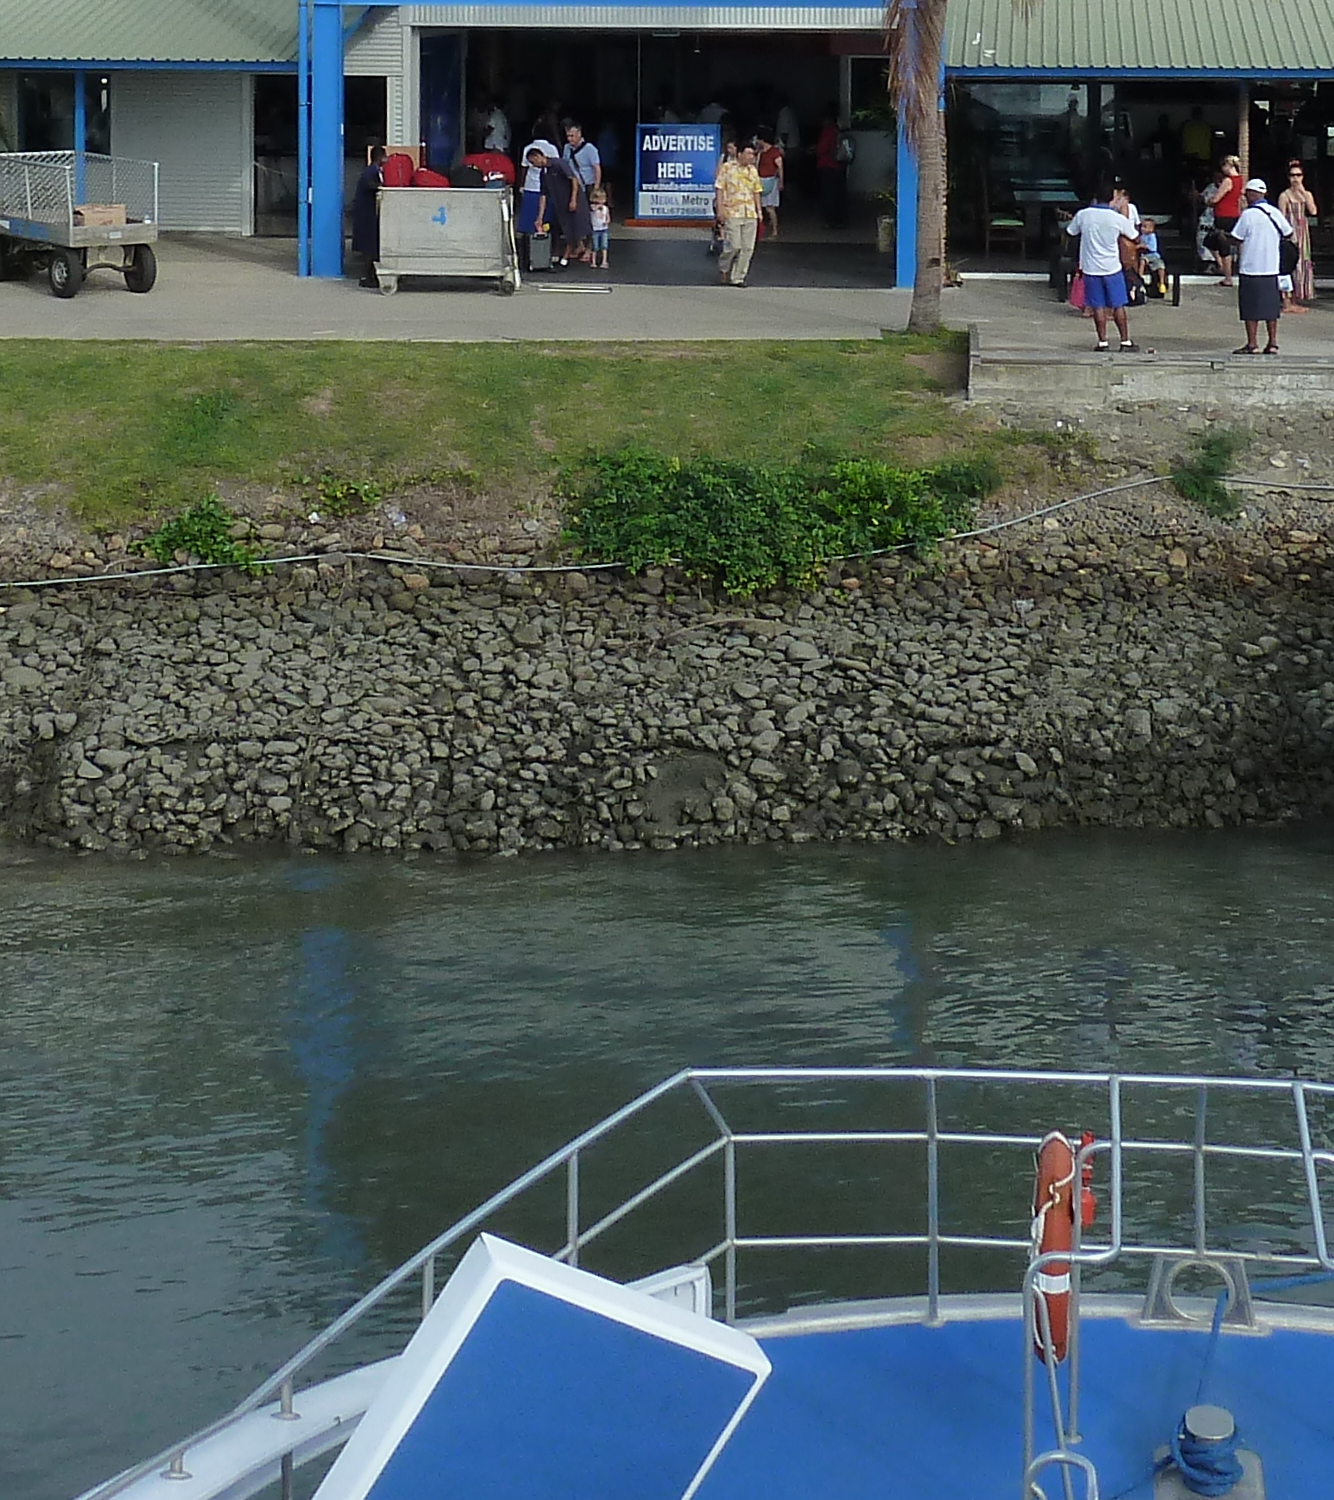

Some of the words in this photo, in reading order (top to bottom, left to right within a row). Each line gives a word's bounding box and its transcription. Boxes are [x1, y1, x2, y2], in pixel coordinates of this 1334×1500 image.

[642, 134, 715, 151] ADVERTISE
[657, 162, 693, 178] HERE
[681, 194, 710, 206] Metro
